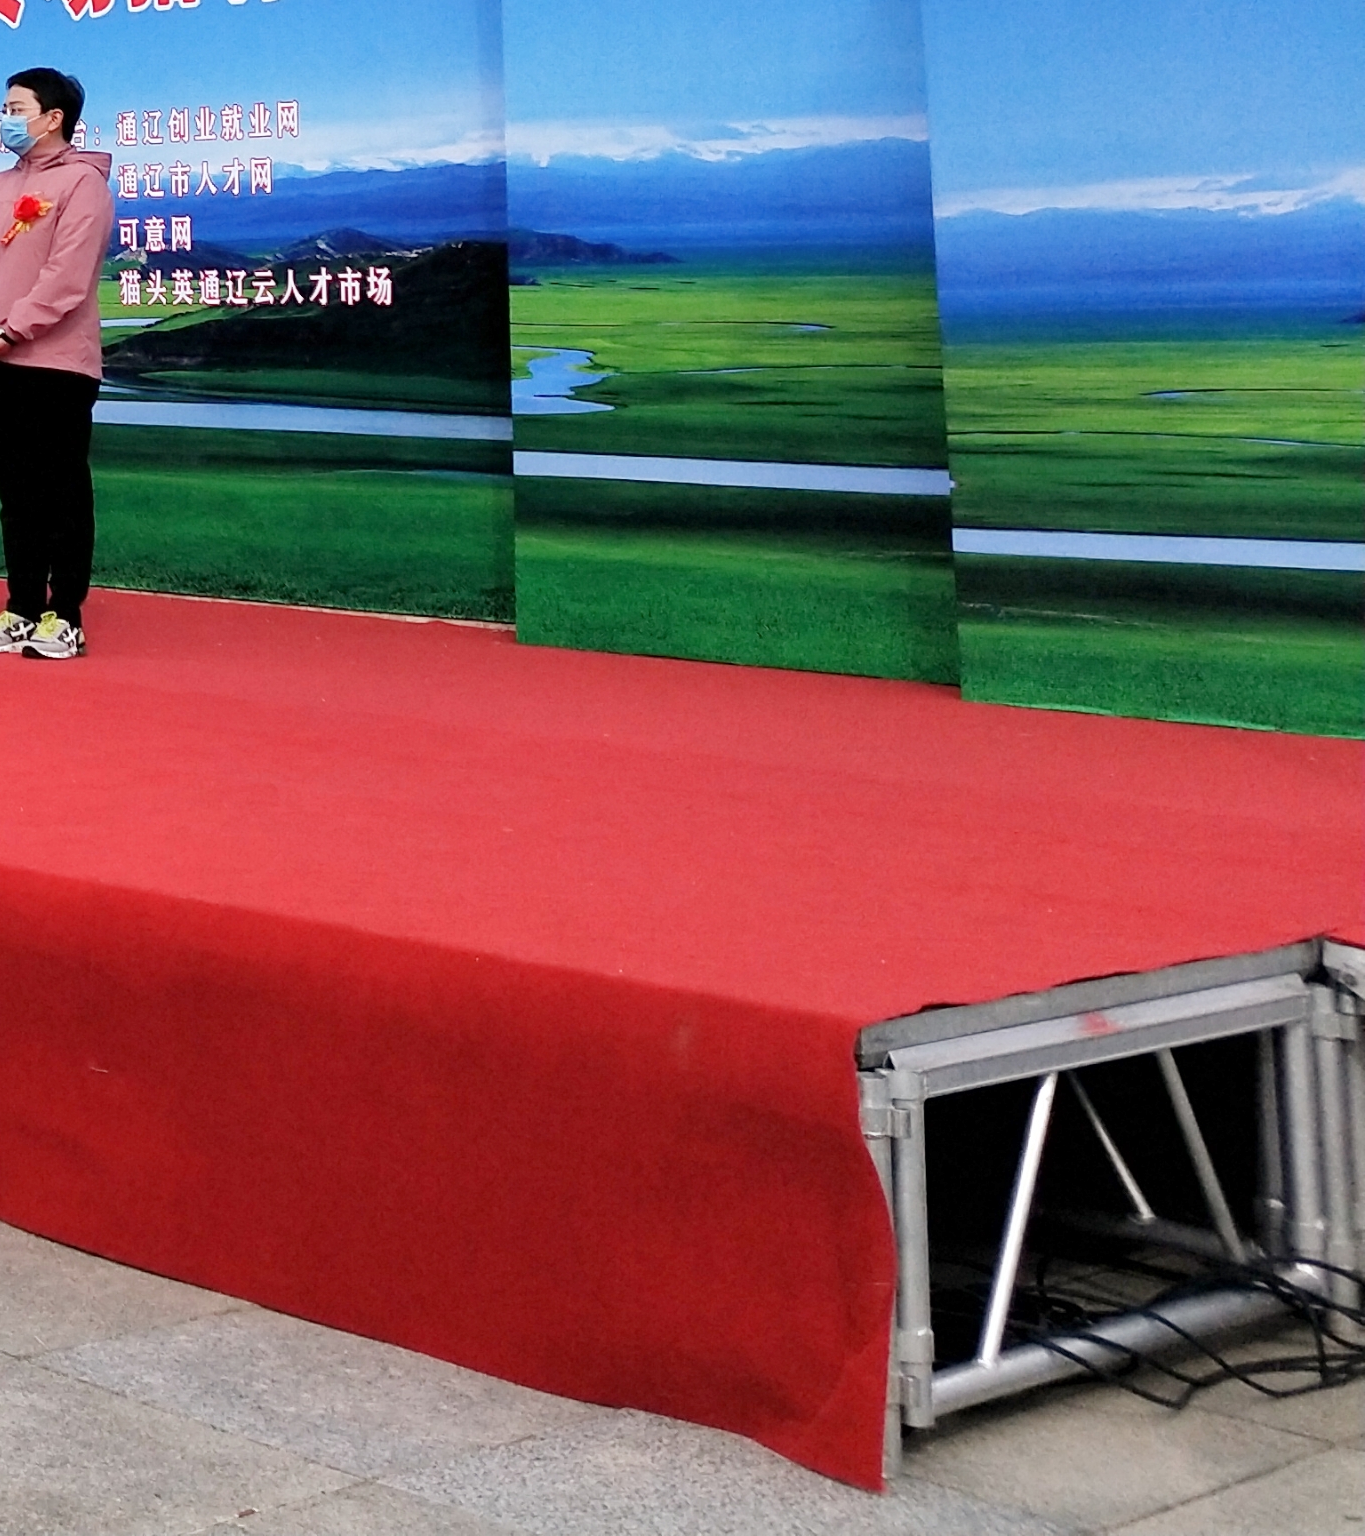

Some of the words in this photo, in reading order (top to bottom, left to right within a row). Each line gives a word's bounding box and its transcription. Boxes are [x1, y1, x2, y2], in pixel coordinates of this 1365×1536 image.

[116, 99, 300, 147] 通辽创业就业网
[117, 157, 273, 199] 通辽市人才网
[118, 214, 193, 252] 可意网
[119, 266, 393, 307] 猫头英通辽云人才市场
